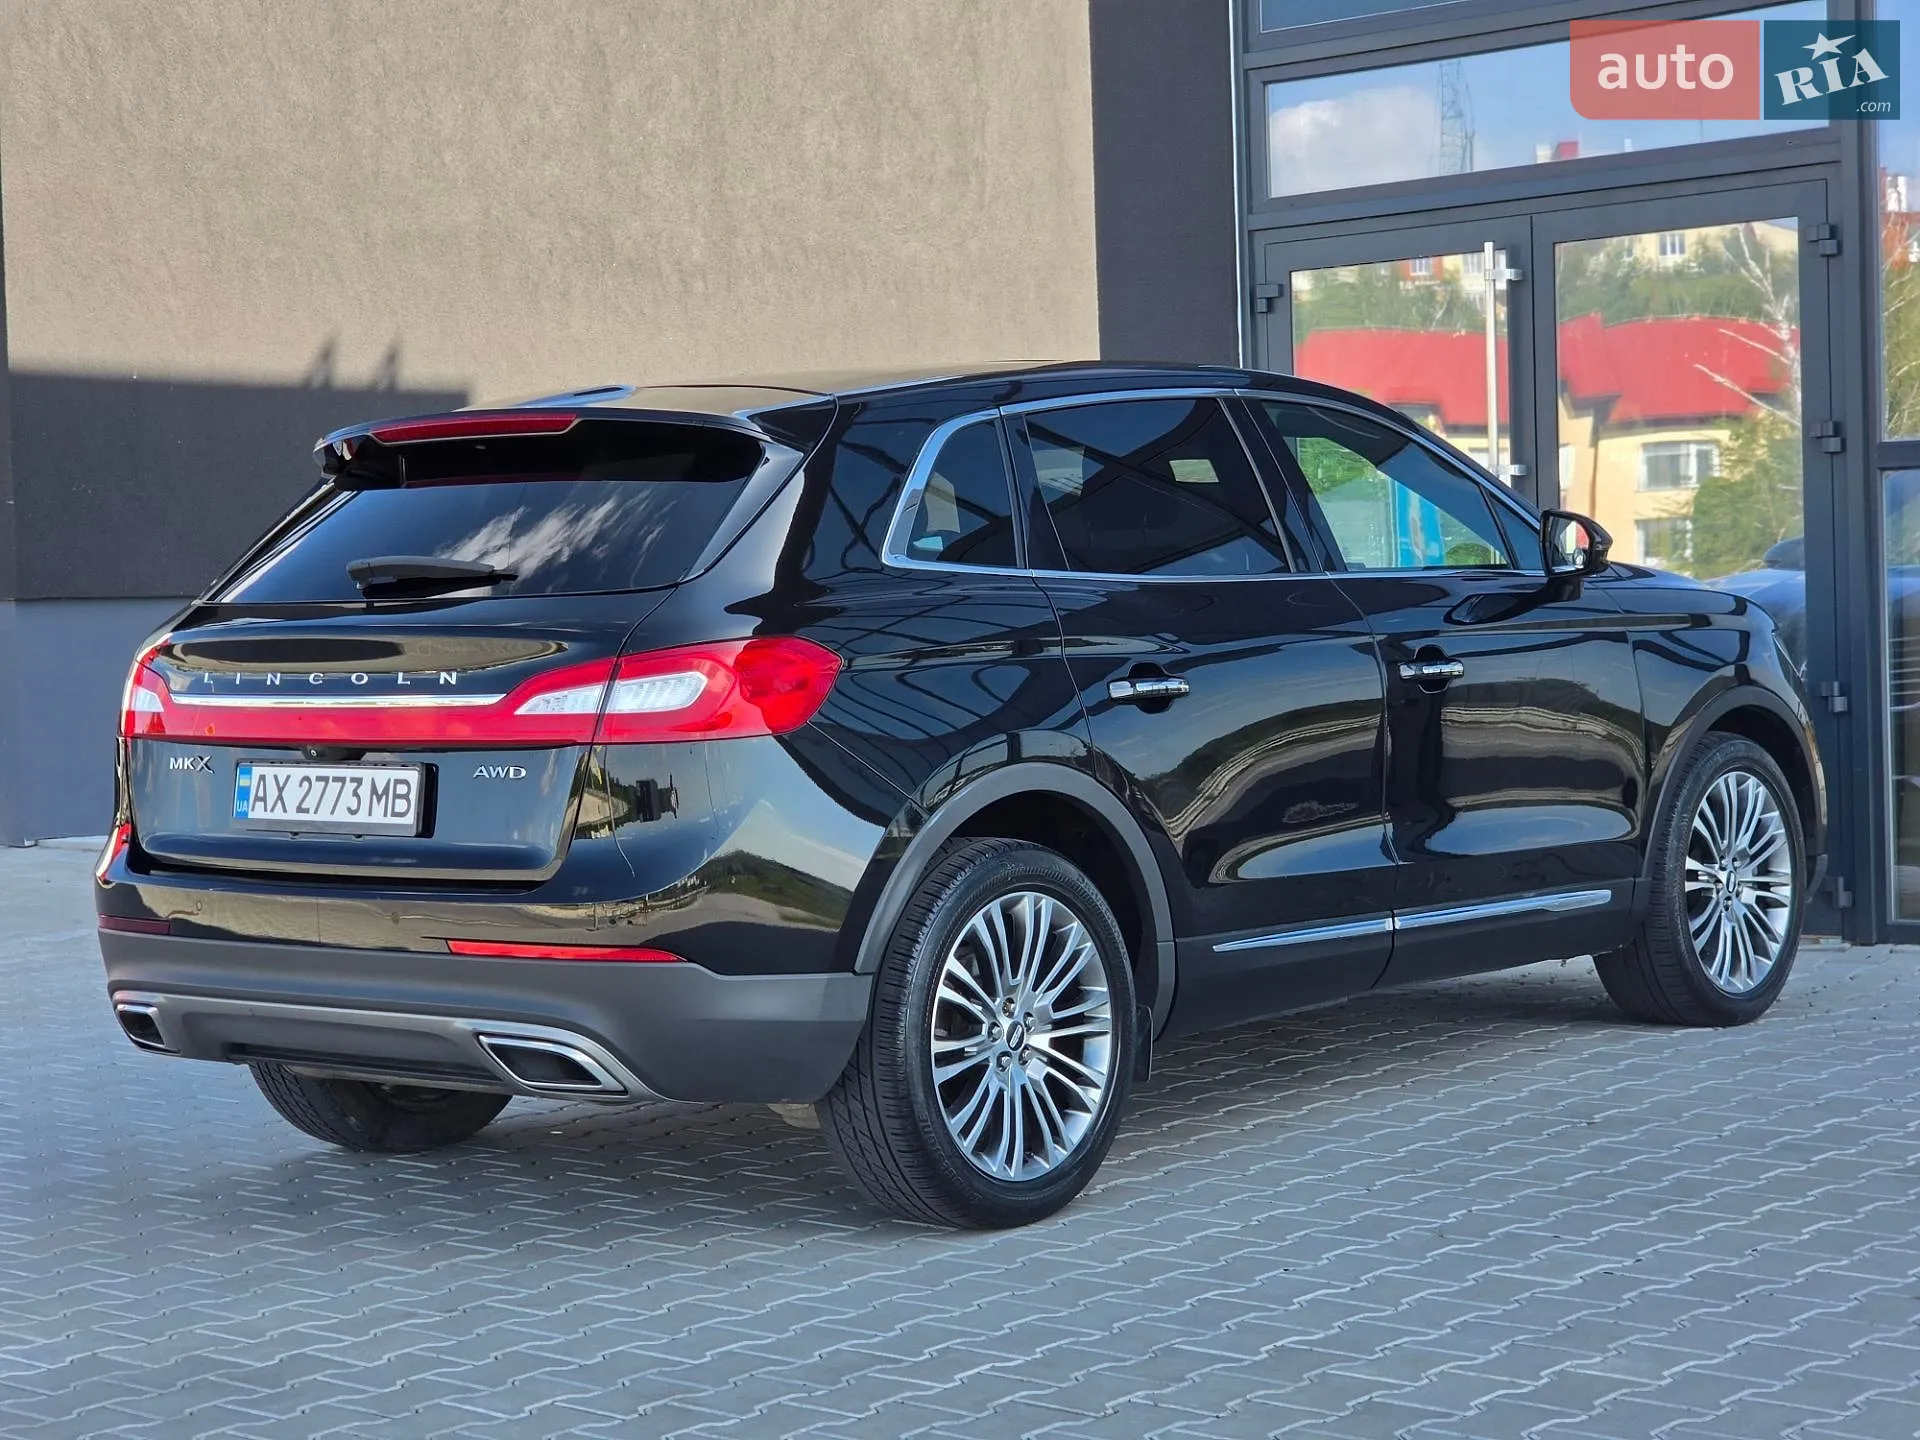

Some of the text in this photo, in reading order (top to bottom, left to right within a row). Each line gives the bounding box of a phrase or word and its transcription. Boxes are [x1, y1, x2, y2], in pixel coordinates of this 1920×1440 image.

[203, 672, 457, 685] LINCOLN
[169, 755, 213, 773] MKX
[473, 764, 527, 780] AWD
[251, 773, 412, 819] AX 2773 MB
[236, 799, 248, 813] UA
